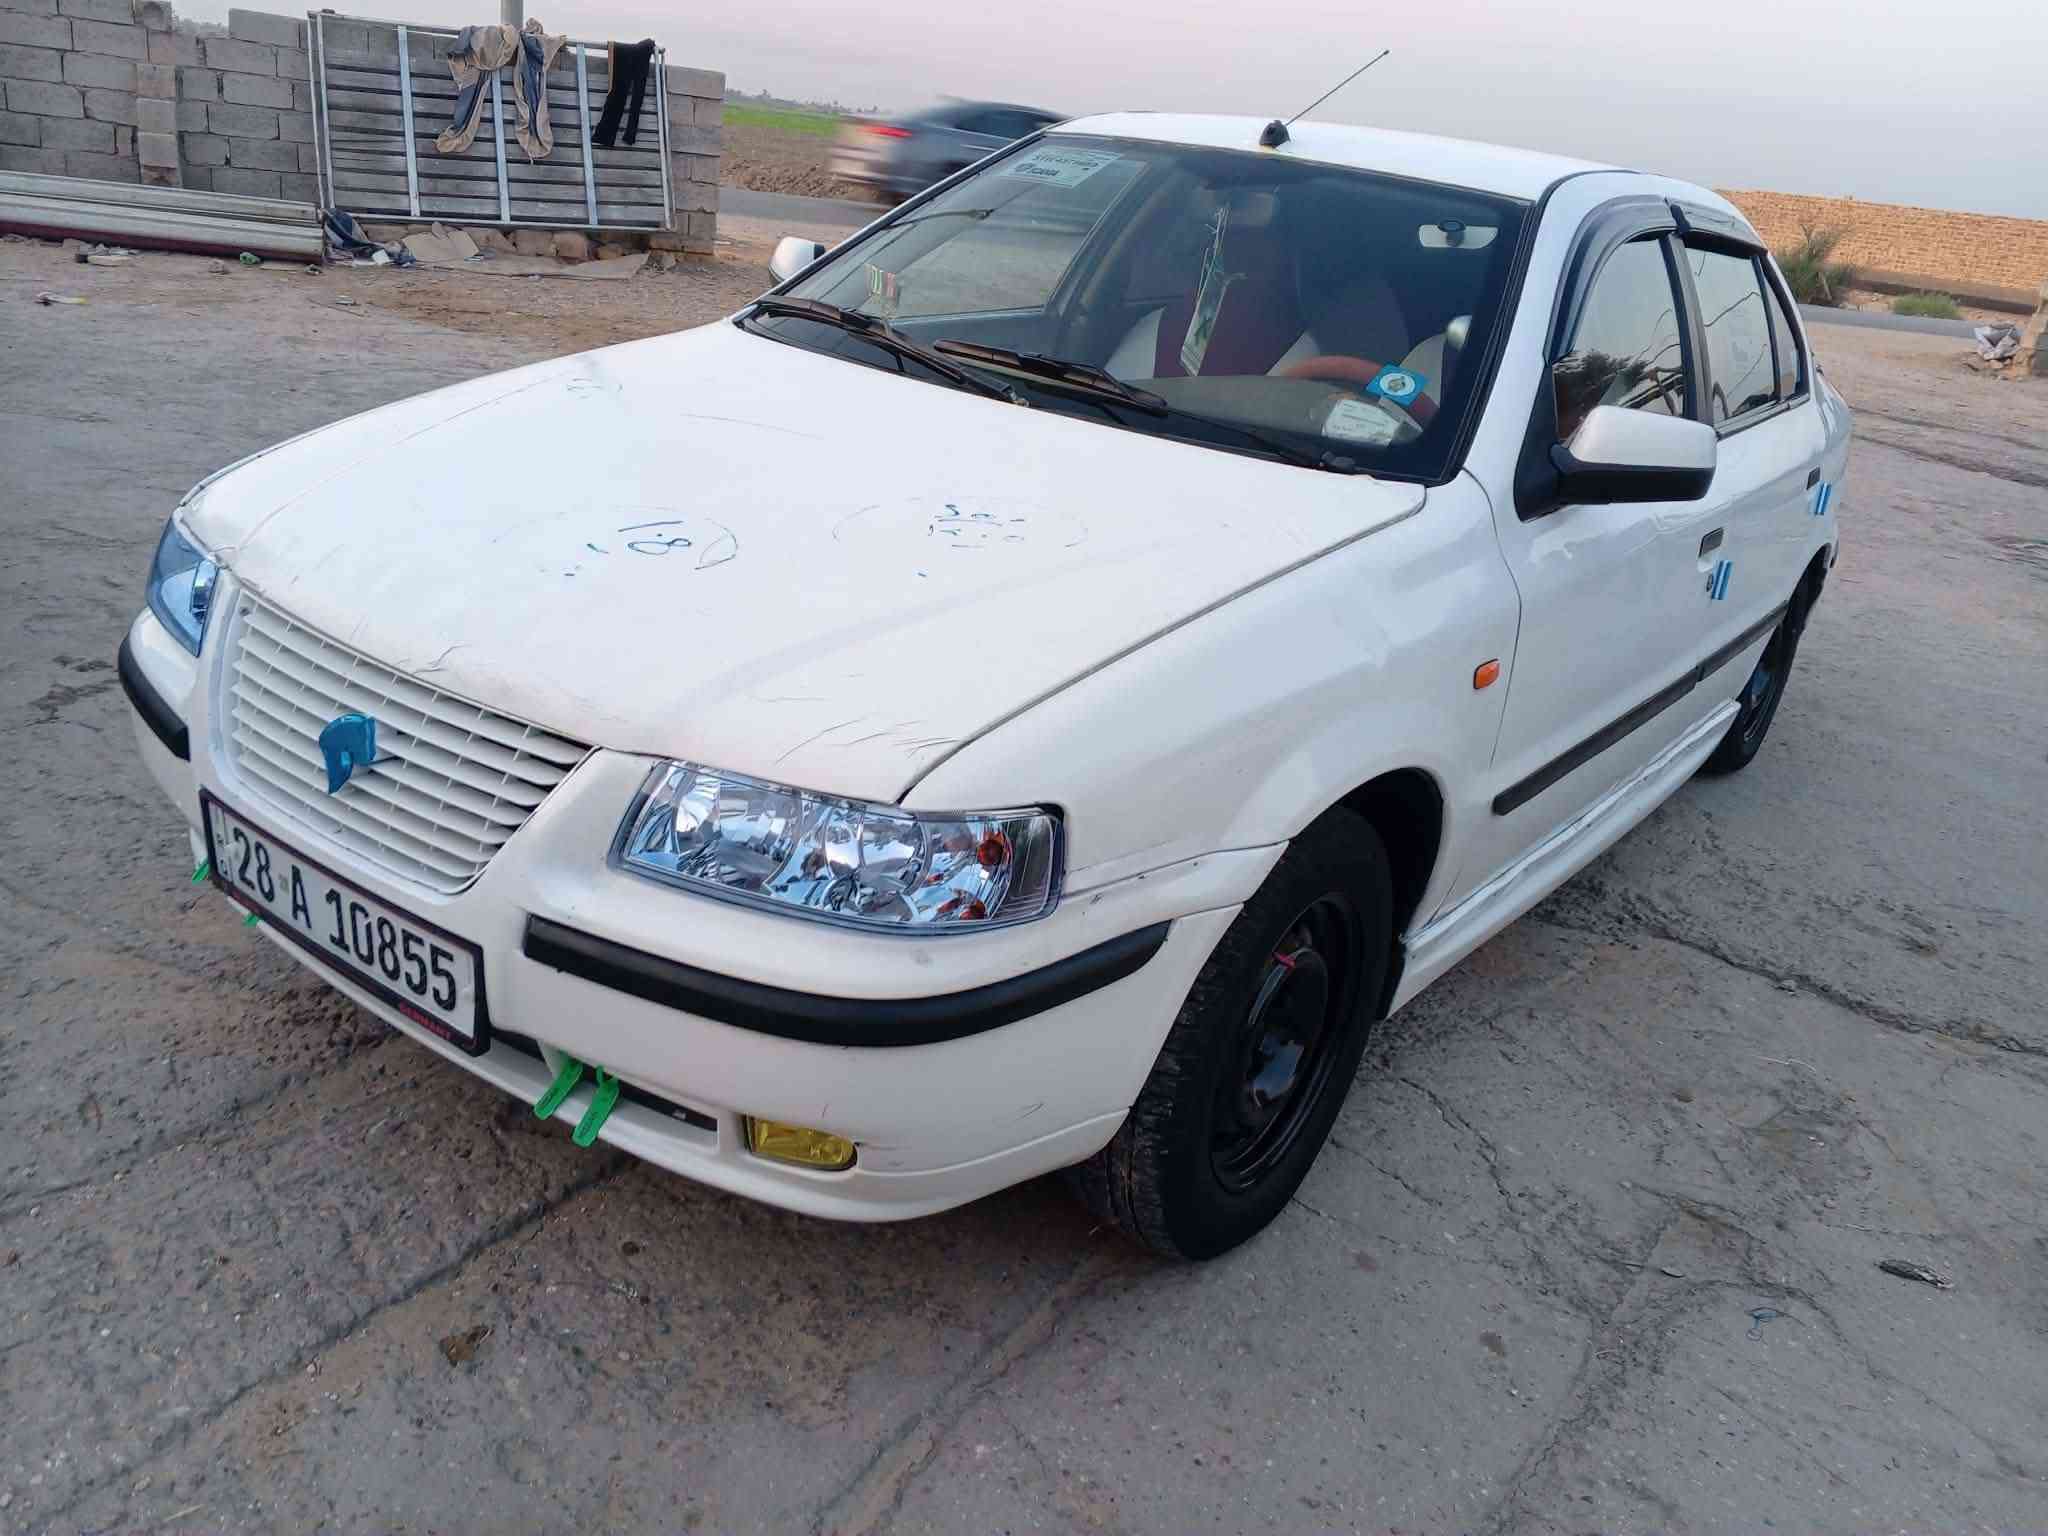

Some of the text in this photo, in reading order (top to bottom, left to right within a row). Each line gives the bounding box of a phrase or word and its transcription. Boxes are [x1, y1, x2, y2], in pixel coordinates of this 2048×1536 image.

[233, 827, 275, 903] 28
[291, 864, 312, 930] A
[325, 888, 457, 1012] 10855
